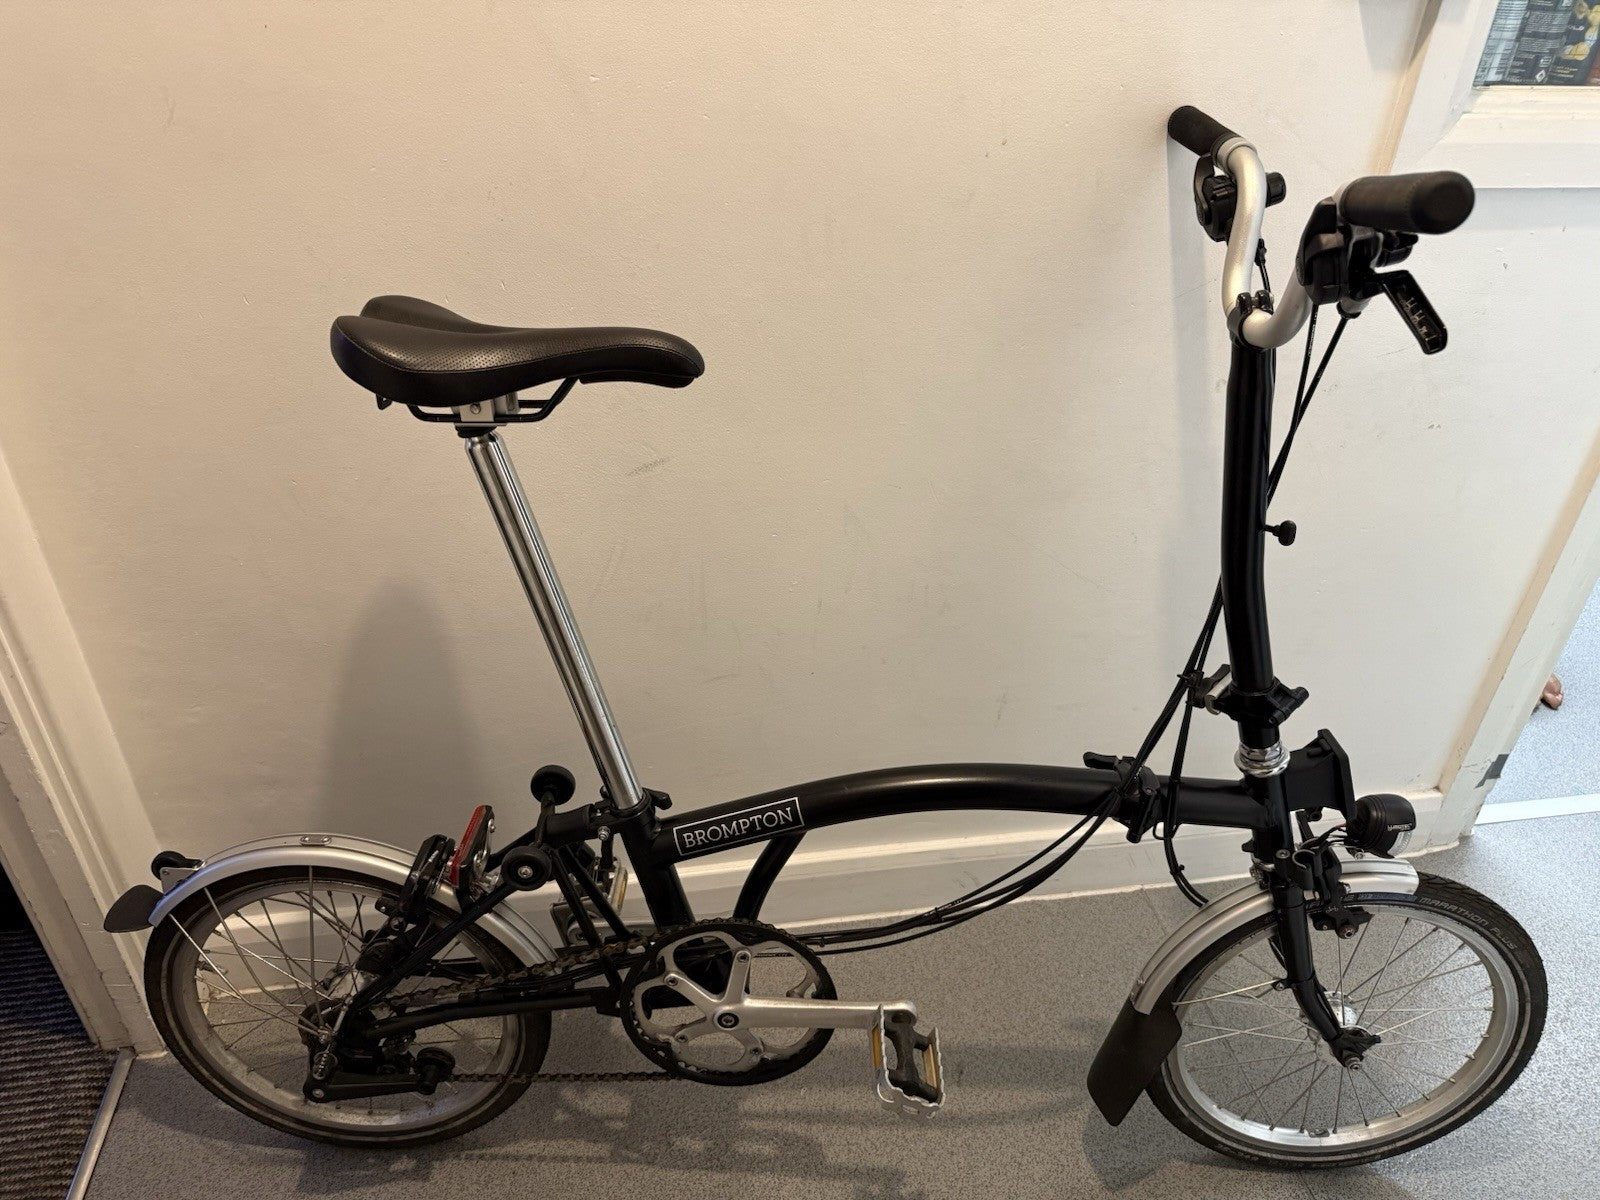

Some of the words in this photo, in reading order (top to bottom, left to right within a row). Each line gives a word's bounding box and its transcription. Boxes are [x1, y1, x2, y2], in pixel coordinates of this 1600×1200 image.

[682, 806, 793, 848] BROMPTON
[1419, 896, 1489, 927] MARATHON
[1490, 926, 1518, 950] PLUS
